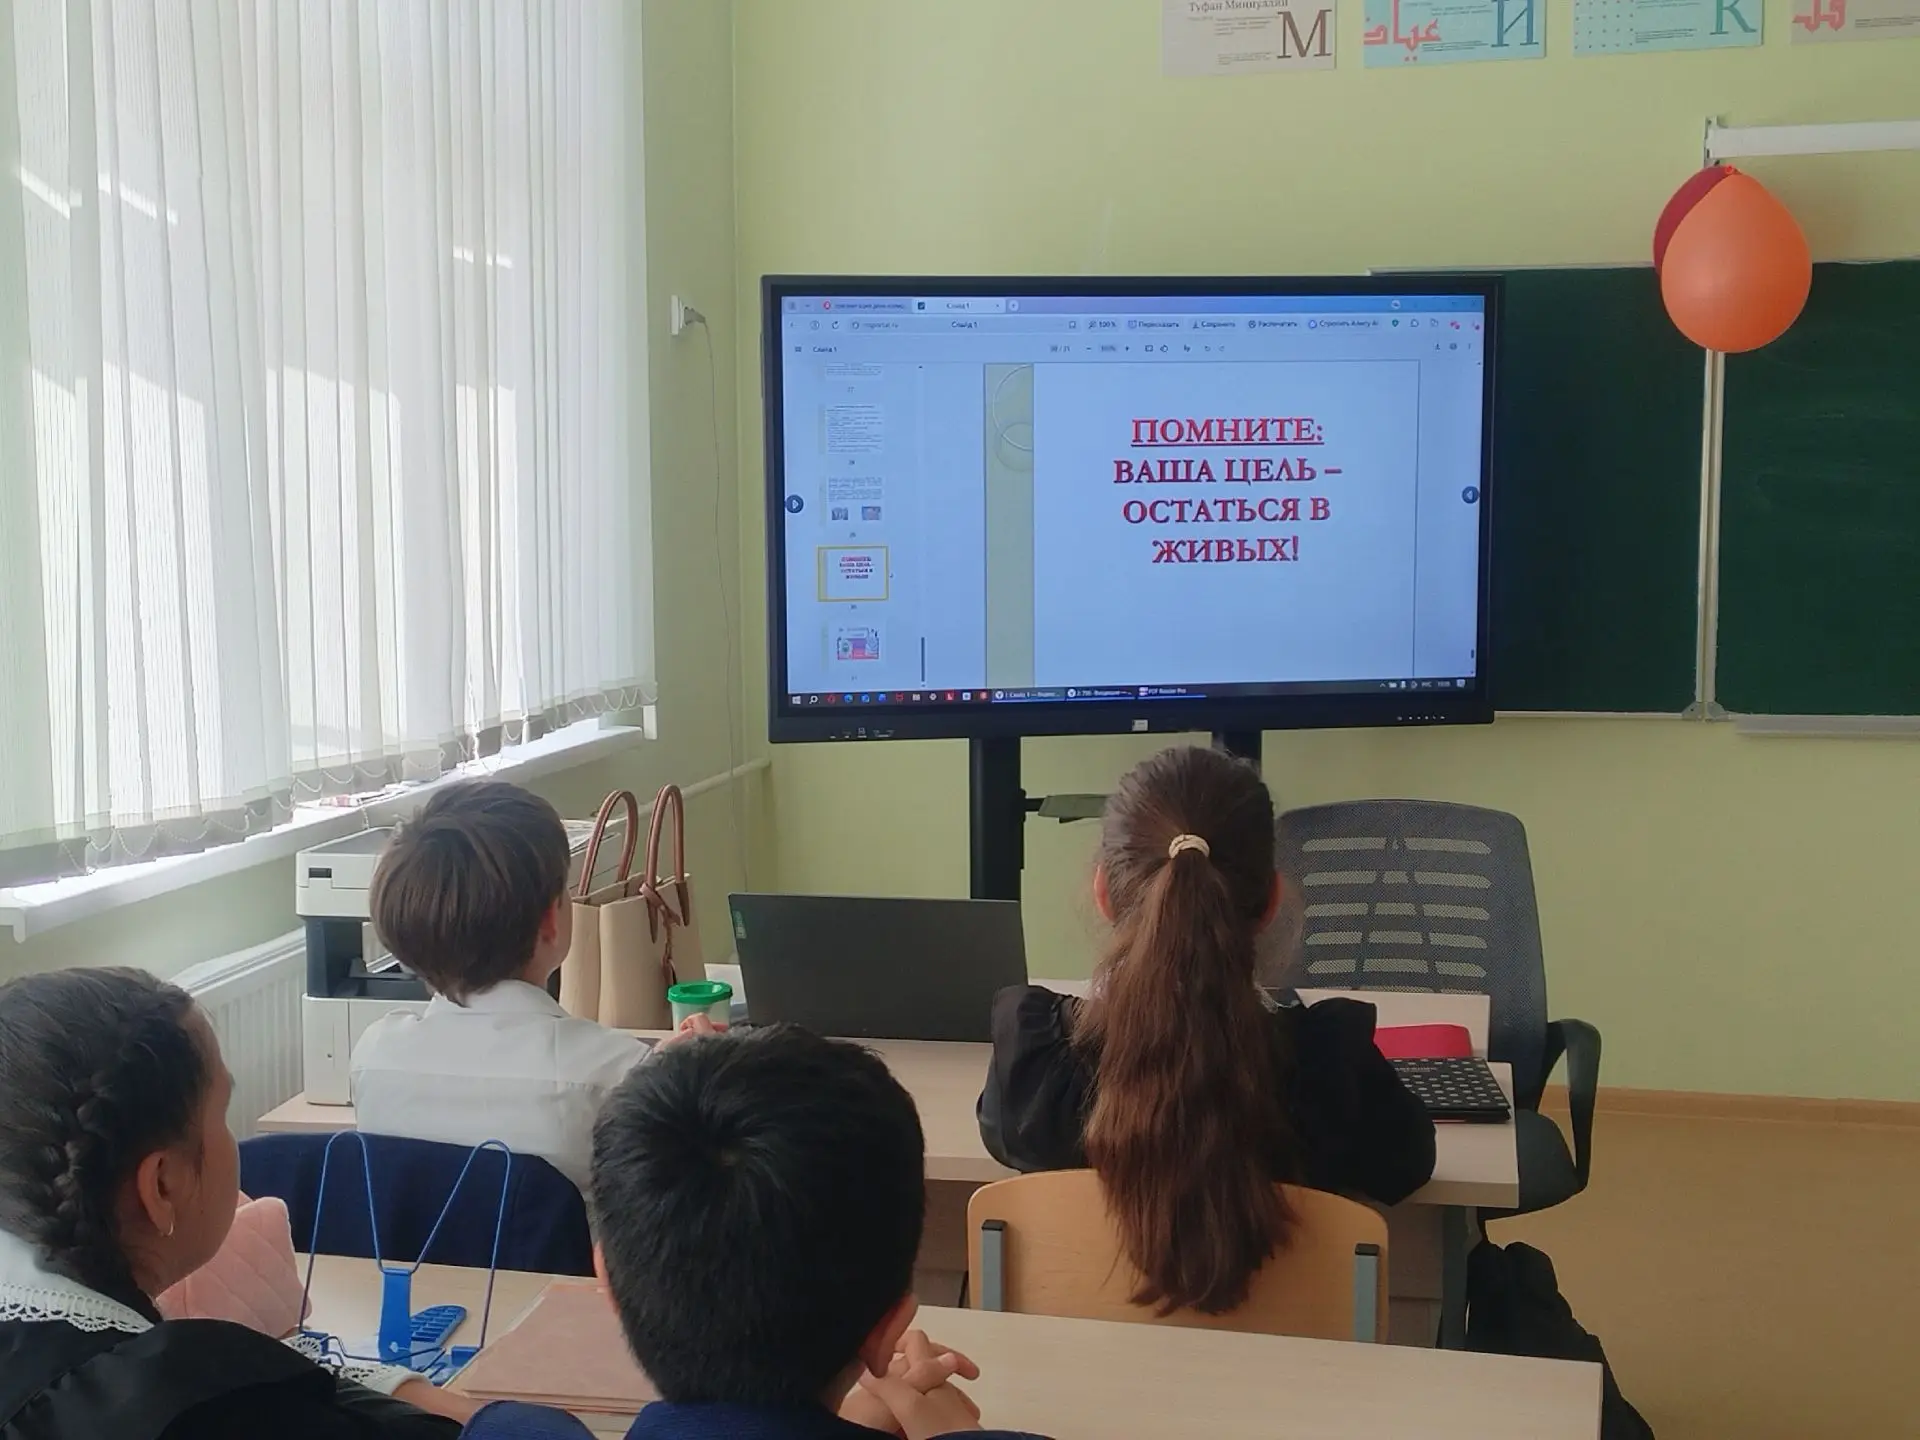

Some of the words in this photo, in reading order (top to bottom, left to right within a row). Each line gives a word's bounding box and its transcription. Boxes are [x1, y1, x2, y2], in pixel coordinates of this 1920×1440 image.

[1131, 417, 1324, 446] ПОМНИТЕ:
[1113, 459, 1216, 483] ВАША
[1224, 458, 1317, 486] ЦЕЛЬ
[1123, 498, 1301, 523] ОСТАТЬСЯ
[1310, 497, 1330, 521] В
[1152, 536, 1299, 563] ЖИВЫХ!
